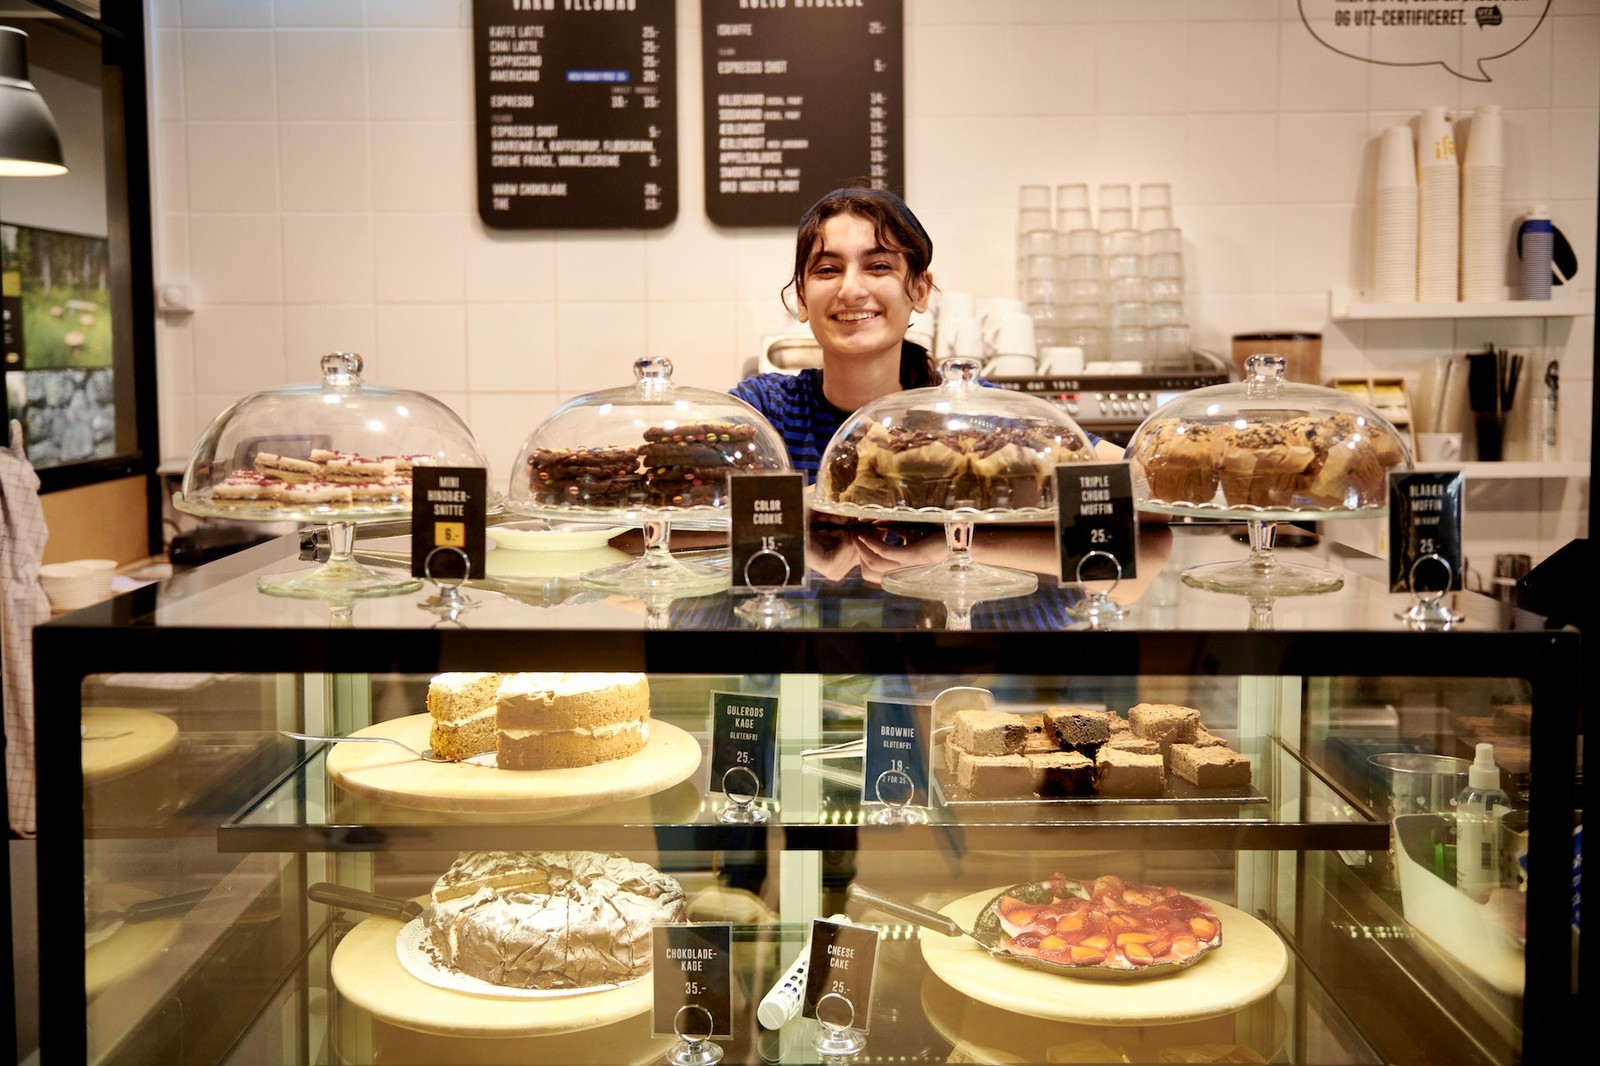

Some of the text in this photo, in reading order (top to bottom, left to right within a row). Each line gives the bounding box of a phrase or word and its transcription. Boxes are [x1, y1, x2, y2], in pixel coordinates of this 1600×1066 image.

[1335, 9, 1351, 26] OG
[1354, 9, 1467, 26] UTZ-CERTIFICERET.
[489, 26, 544, 38] KAFFE LATTE
[489, 41, 538, 53] CHAI LATTE
[489, 55, 542, 67] CAPPUCCINO
[717, 60, 787, 74] ESPRESSO SHOT
[489, 70, 540, 82] AMERICANO
[490, 95, 534, 108] ESPRESSO
[491, 126, 558, 138] ESPRESSO SHOT
[492, 184, 568, 196] VARM CHOKOLADE
[439, 476, 460, 488] MINI
[1079, 475, 1110, 488] TRIPLE
[427, 490, 471, 502] HINDBÆR-
[1081, 489, 1110, 502] CHOKO
[433, 504, 464, 516] SNITTE
[754, 500, 781, 512] COLOR
[1080, 503, 1113, 516] MUFFIN
[1411, 499, 1442, 512] MUFFIN
[752, 513, 783, 525] COOKIE
[445, 528, 460, 541] 6.-
[1090, 529, 1112, 543] 25.-
[761, 536, 783, 550] 15.-
[726, 705, 764, 718] GULERODS
[735, 718, 754, 729] KAGE
[729, 731, 758, 741] GLUTENFRI
[880, 725, 915, 738] BROWNIE
[883, 740, 912, 750] GLUTENFRI
[736, 751, 754, 764] 25.-
[891, 759, 910, 773] 19.-
[887, 775, 897, 784] FOR
[666, 948, 717, 960] CHOKOLADE-
[827, 944, 855, 959] CHEESE
[681, 961, 702, 971] KAGE
[829, 957, 850, 970] CAKE
[685, 982, 707, 995] 35.-
[832, 980, 851, 994] 25.-
